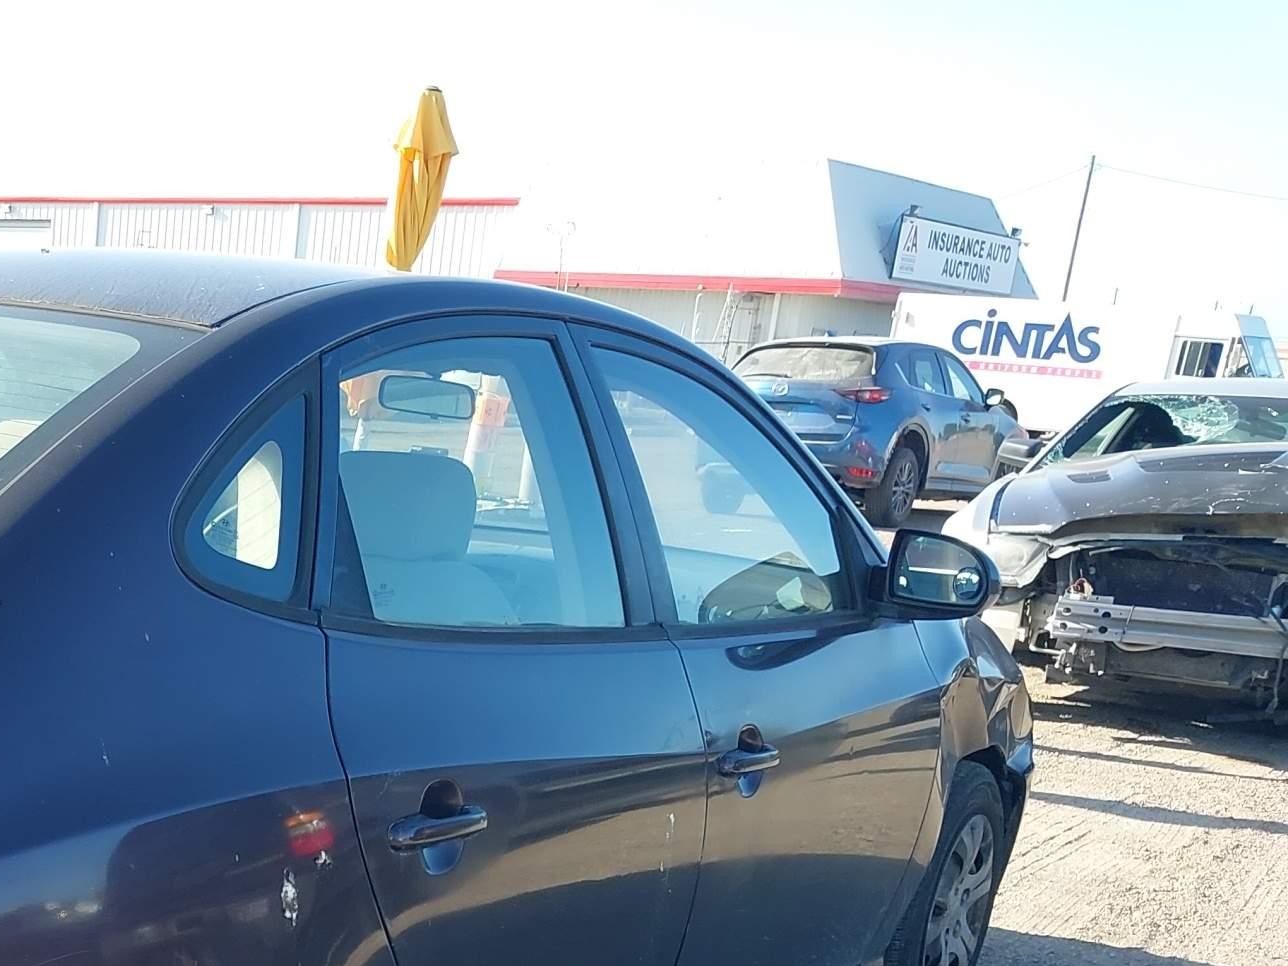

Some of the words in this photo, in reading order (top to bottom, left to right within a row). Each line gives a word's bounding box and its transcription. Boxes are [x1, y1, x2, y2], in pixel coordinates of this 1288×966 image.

[927, 229, 986, 259] INSURANCE
[986, 243, 1012, 264] AUTO
[941, 257, 991, 284] AUCTIONS
